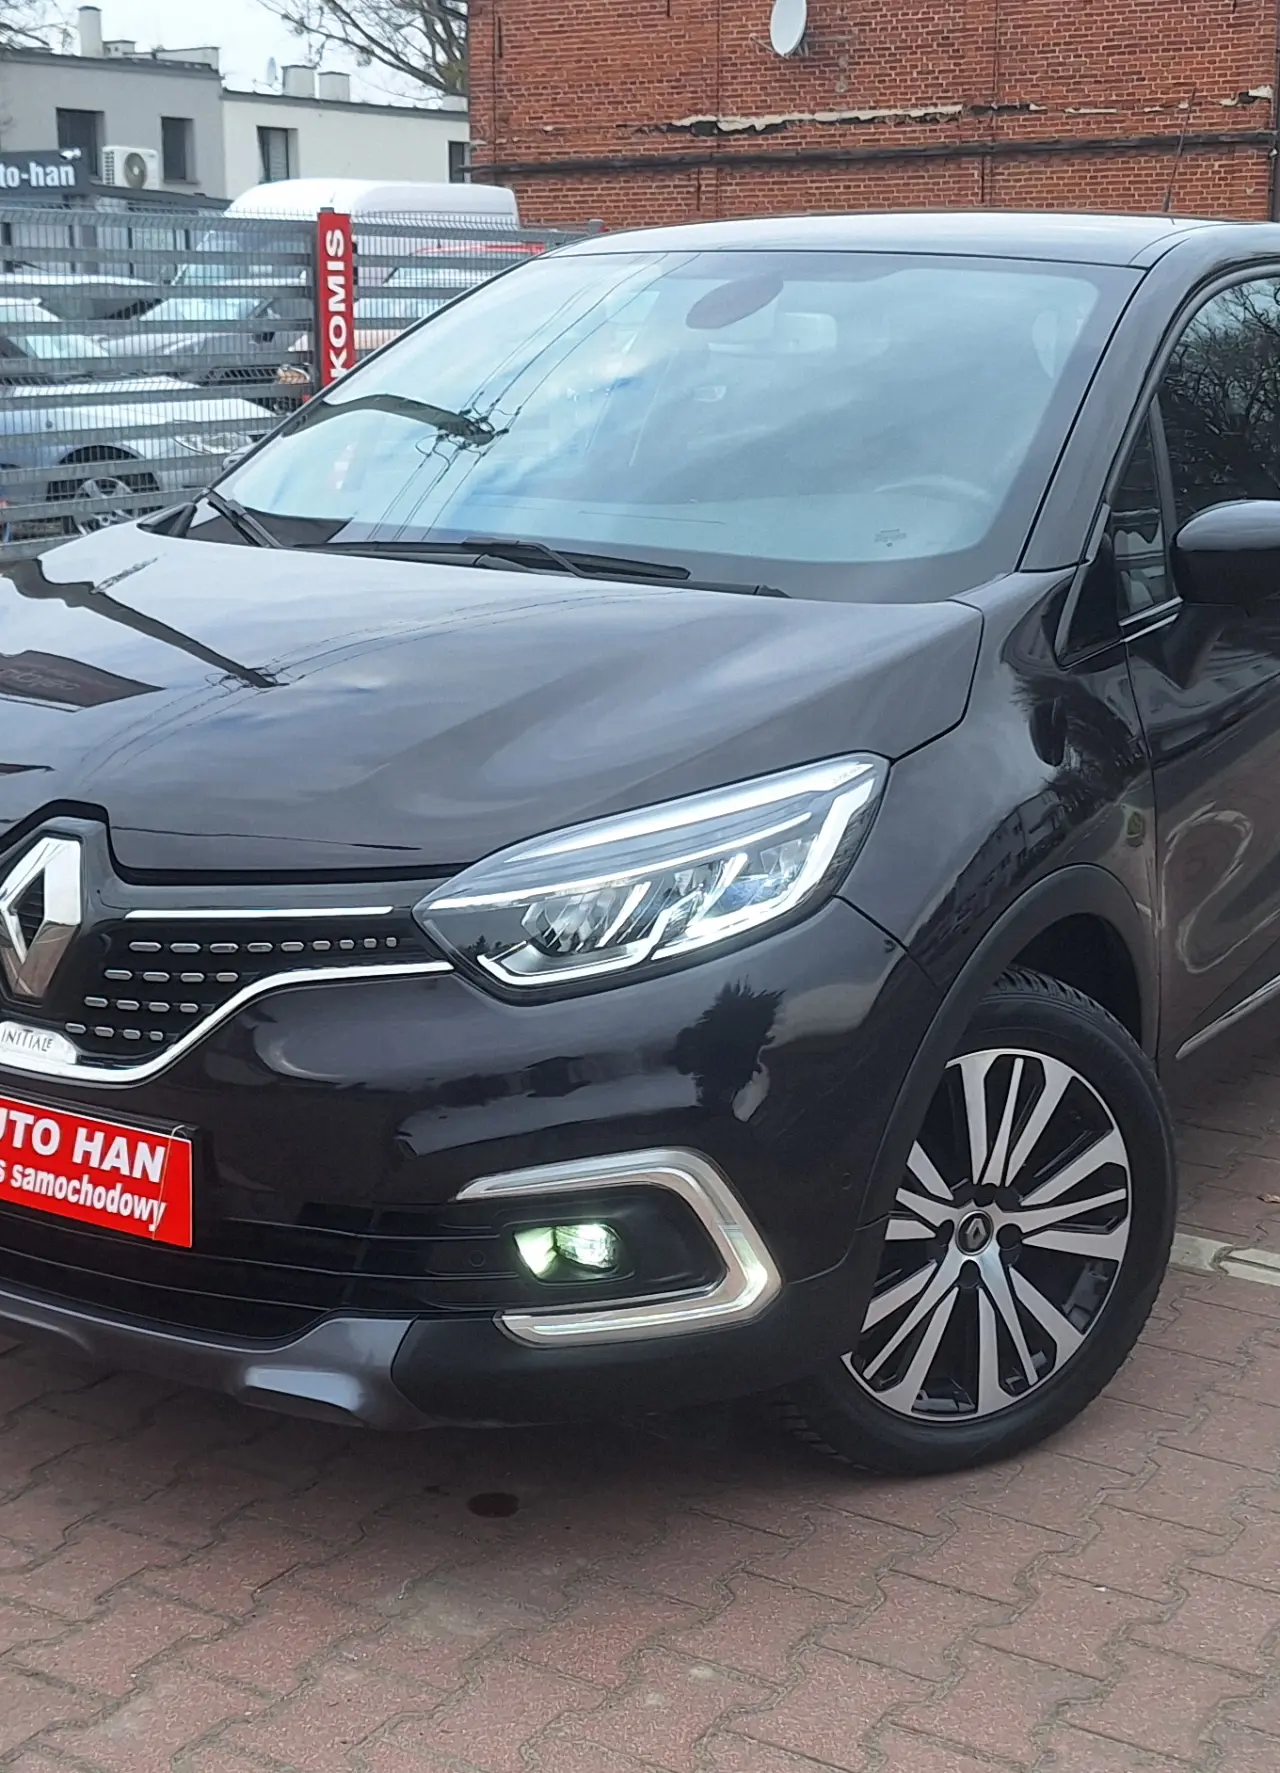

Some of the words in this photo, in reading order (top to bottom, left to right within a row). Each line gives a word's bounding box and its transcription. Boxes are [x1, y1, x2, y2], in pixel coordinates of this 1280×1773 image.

[326, 229, 349, 378] KOMIS
[1, 1028, 53, 1052] INITIALE
[72, 1126, 165, 1184] HAN
[10, 1164, 167, 1232] samochodowy
